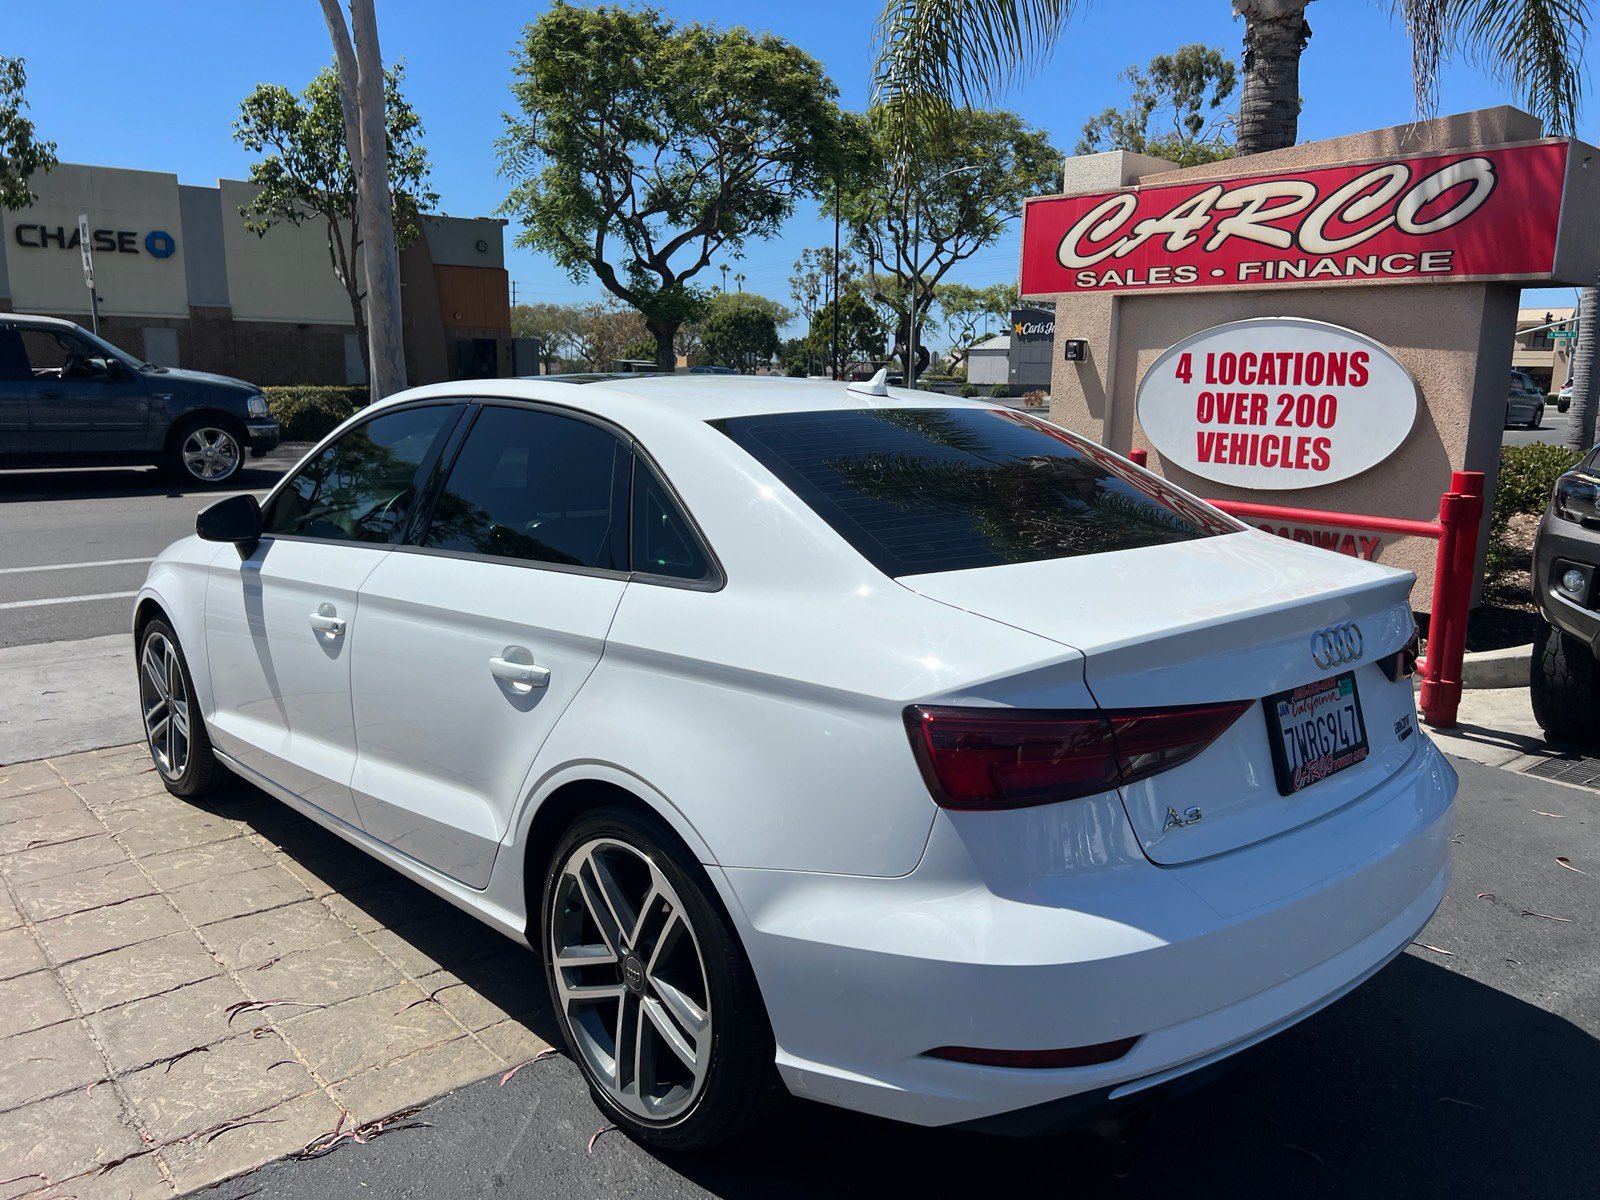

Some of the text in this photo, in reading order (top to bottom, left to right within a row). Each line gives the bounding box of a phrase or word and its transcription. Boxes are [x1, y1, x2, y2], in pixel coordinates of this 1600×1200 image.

[1056, 156, 1498, 270] CARCO
[1075, 250, 1455, 288] SALES FINANCE
[1022, 322, 1045, 335] Carl's
[1175, 351, 1370, 387] 4 LOCATIONS
[1196, 391, 1338, 429] OVER 200
[1196, 431, 1332, 472] VEHICLES
[1291, 690, 1341, 718] California
[1284, 705, 1362, 770] 7WRG947
[1162, 805, 1203, 833] A3
